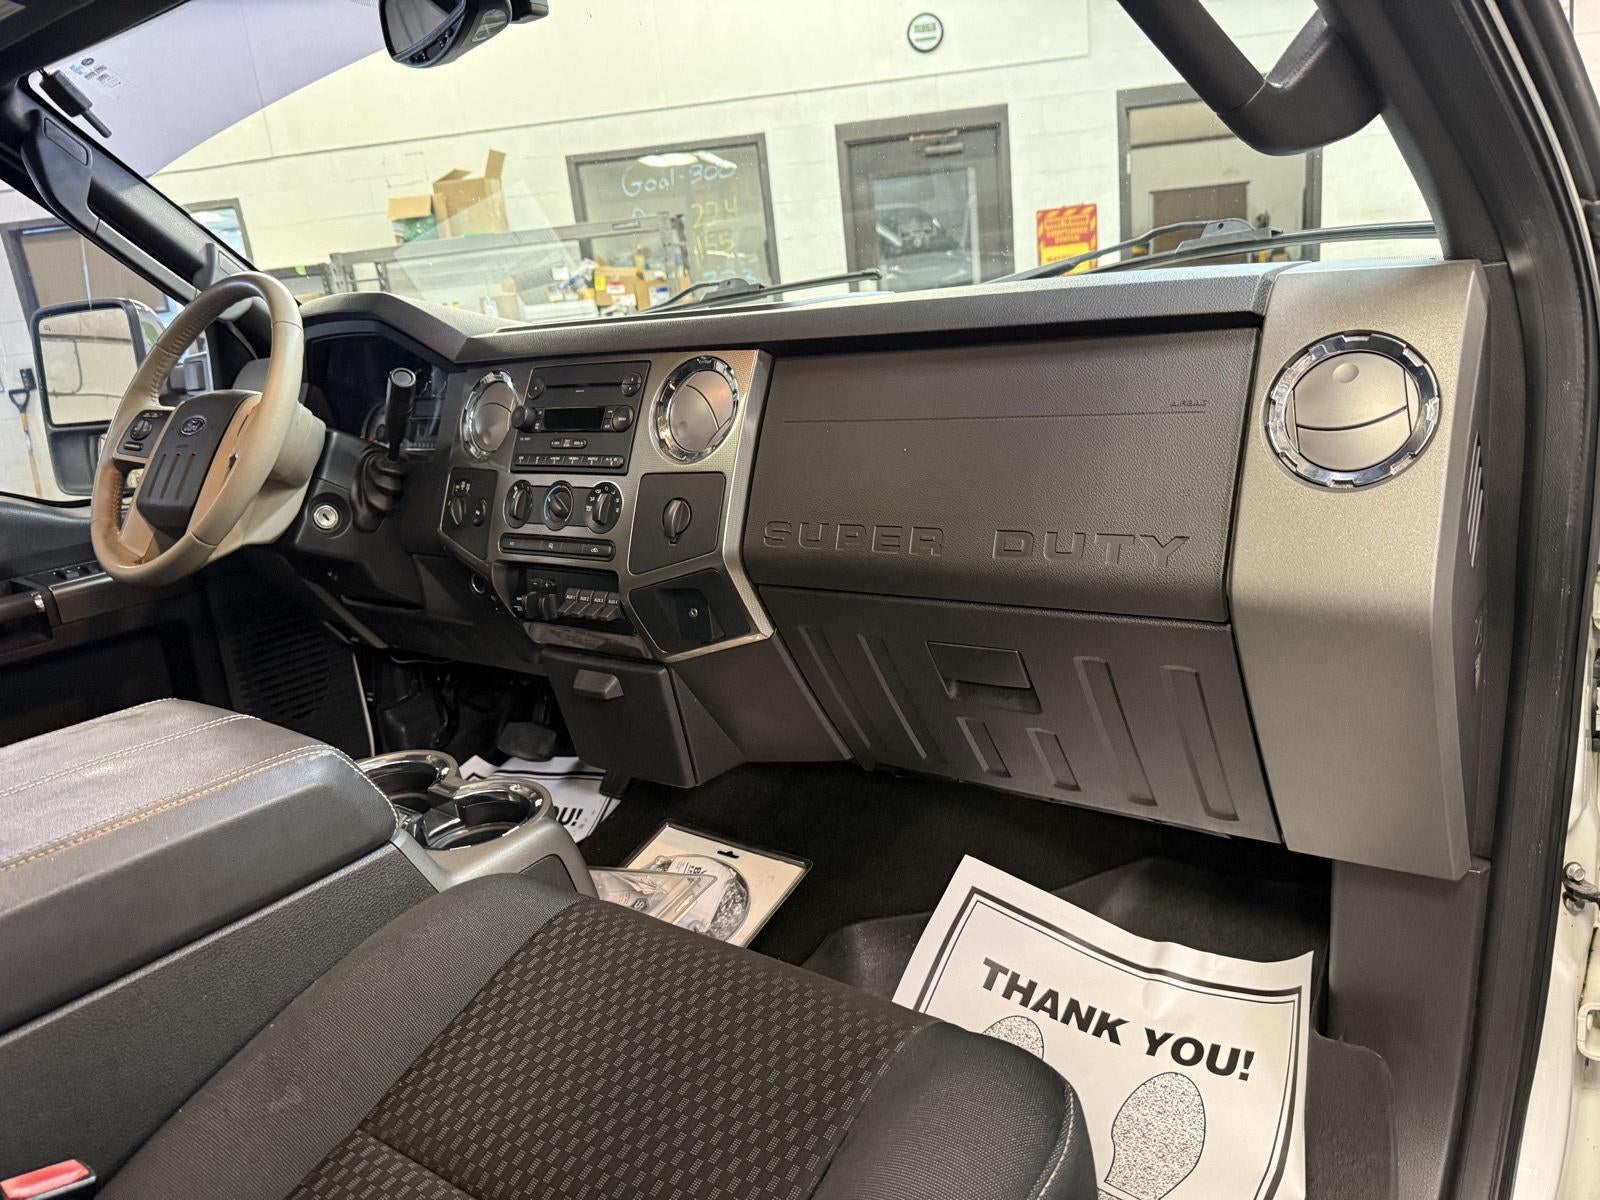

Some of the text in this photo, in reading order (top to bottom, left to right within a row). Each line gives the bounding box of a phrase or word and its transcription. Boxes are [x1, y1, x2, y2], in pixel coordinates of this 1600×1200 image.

[621, 166, 675, 198] Goal
[763, 520, 1190, 568] SUPER DUTY
[981, 957, 1256, 1082] THANK YOU!
